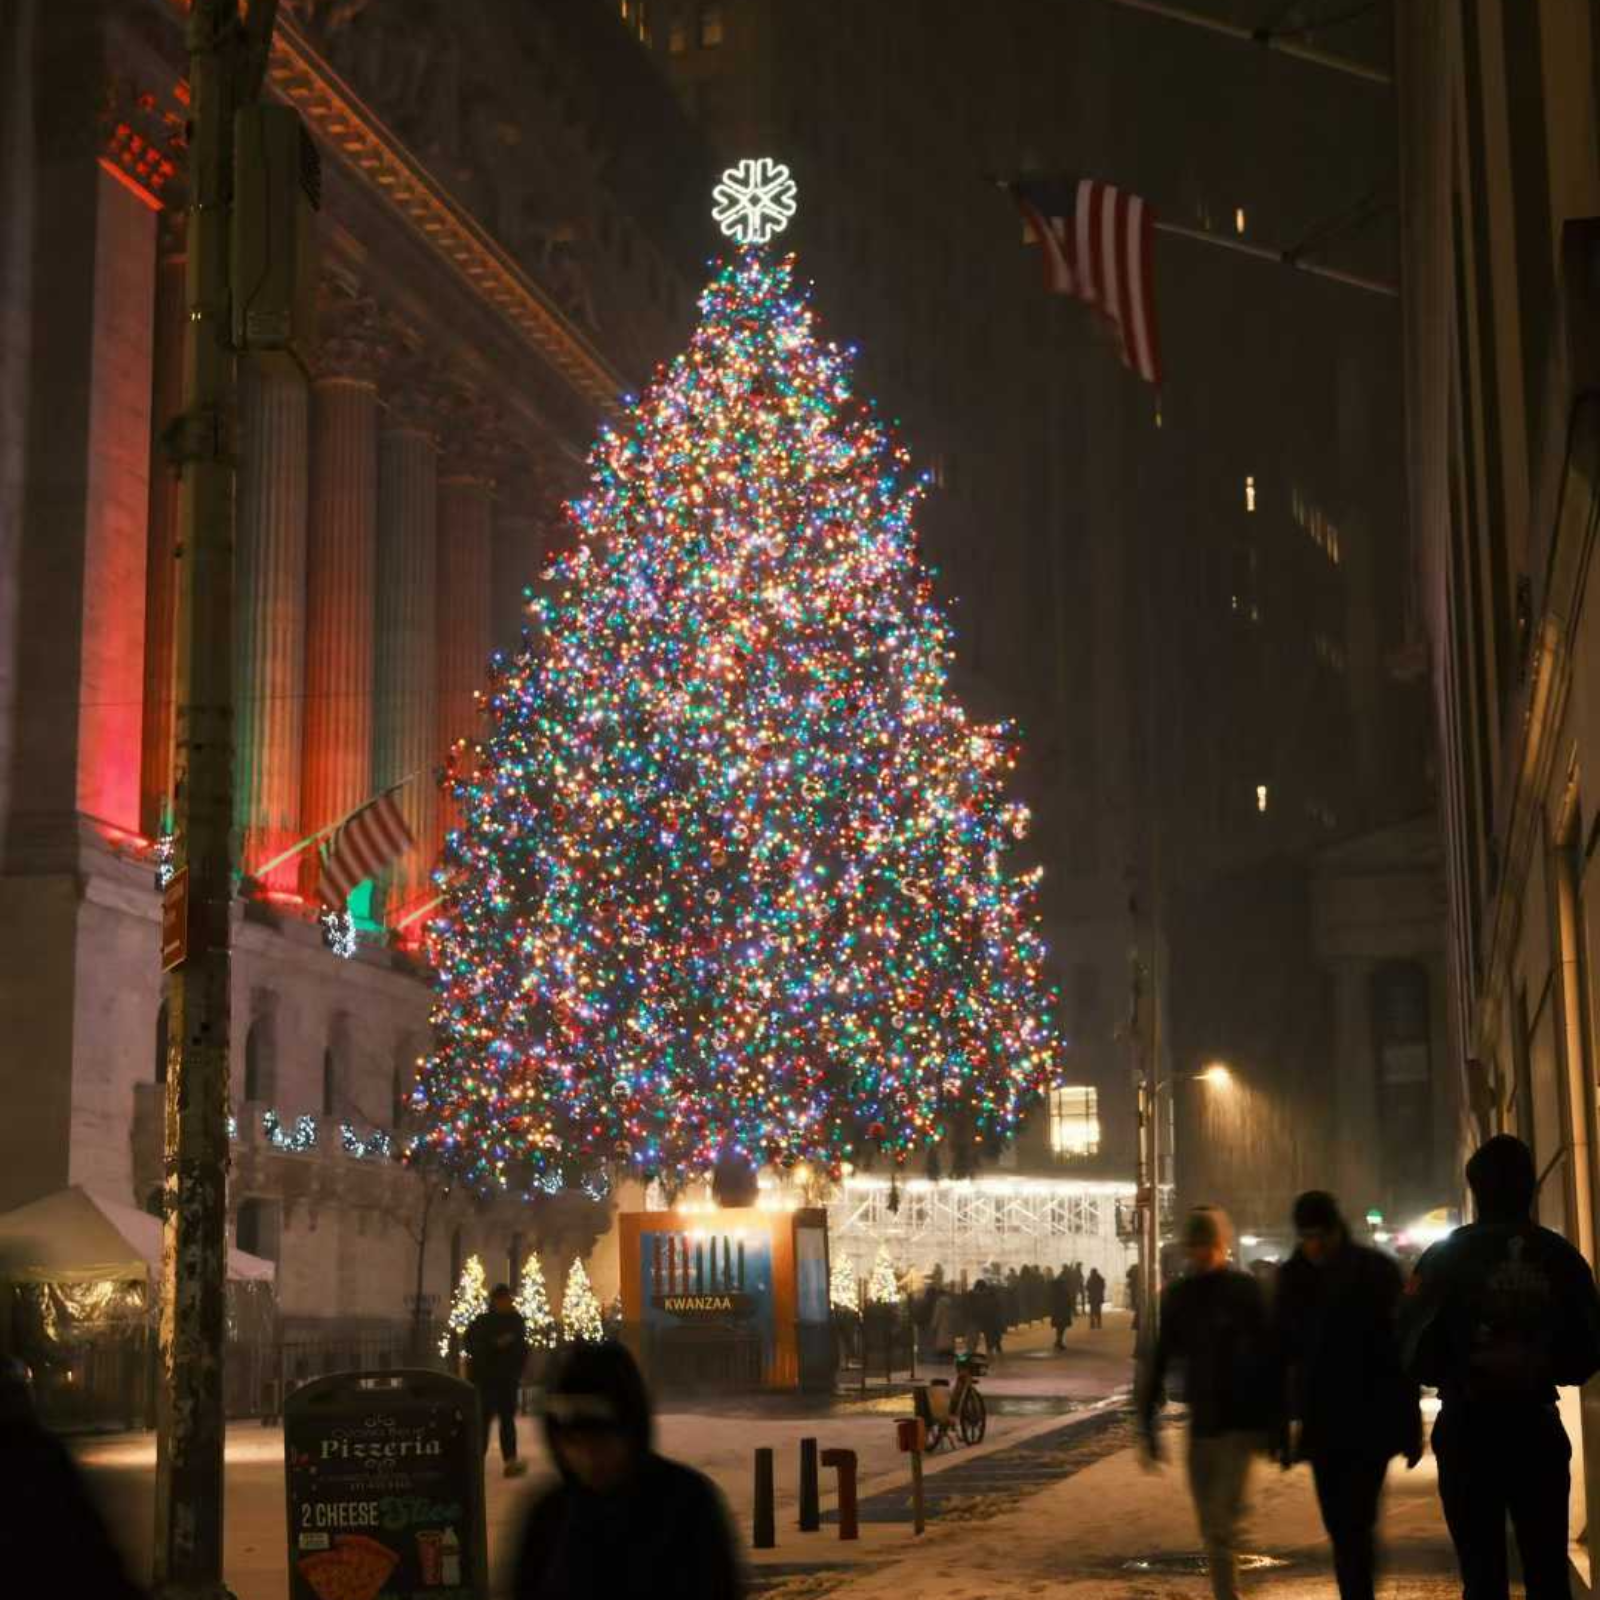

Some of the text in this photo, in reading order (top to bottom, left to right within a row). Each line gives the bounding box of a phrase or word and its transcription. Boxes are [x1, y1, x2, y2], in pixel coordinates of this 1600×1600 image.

[664, 1297, 731, 1310] KWANZAA
[320, 1436, 442, 1459] Pizzeria
[302, 1503, 312, 1528] 2
[316, 1501, 379, 1527] CHEESE
